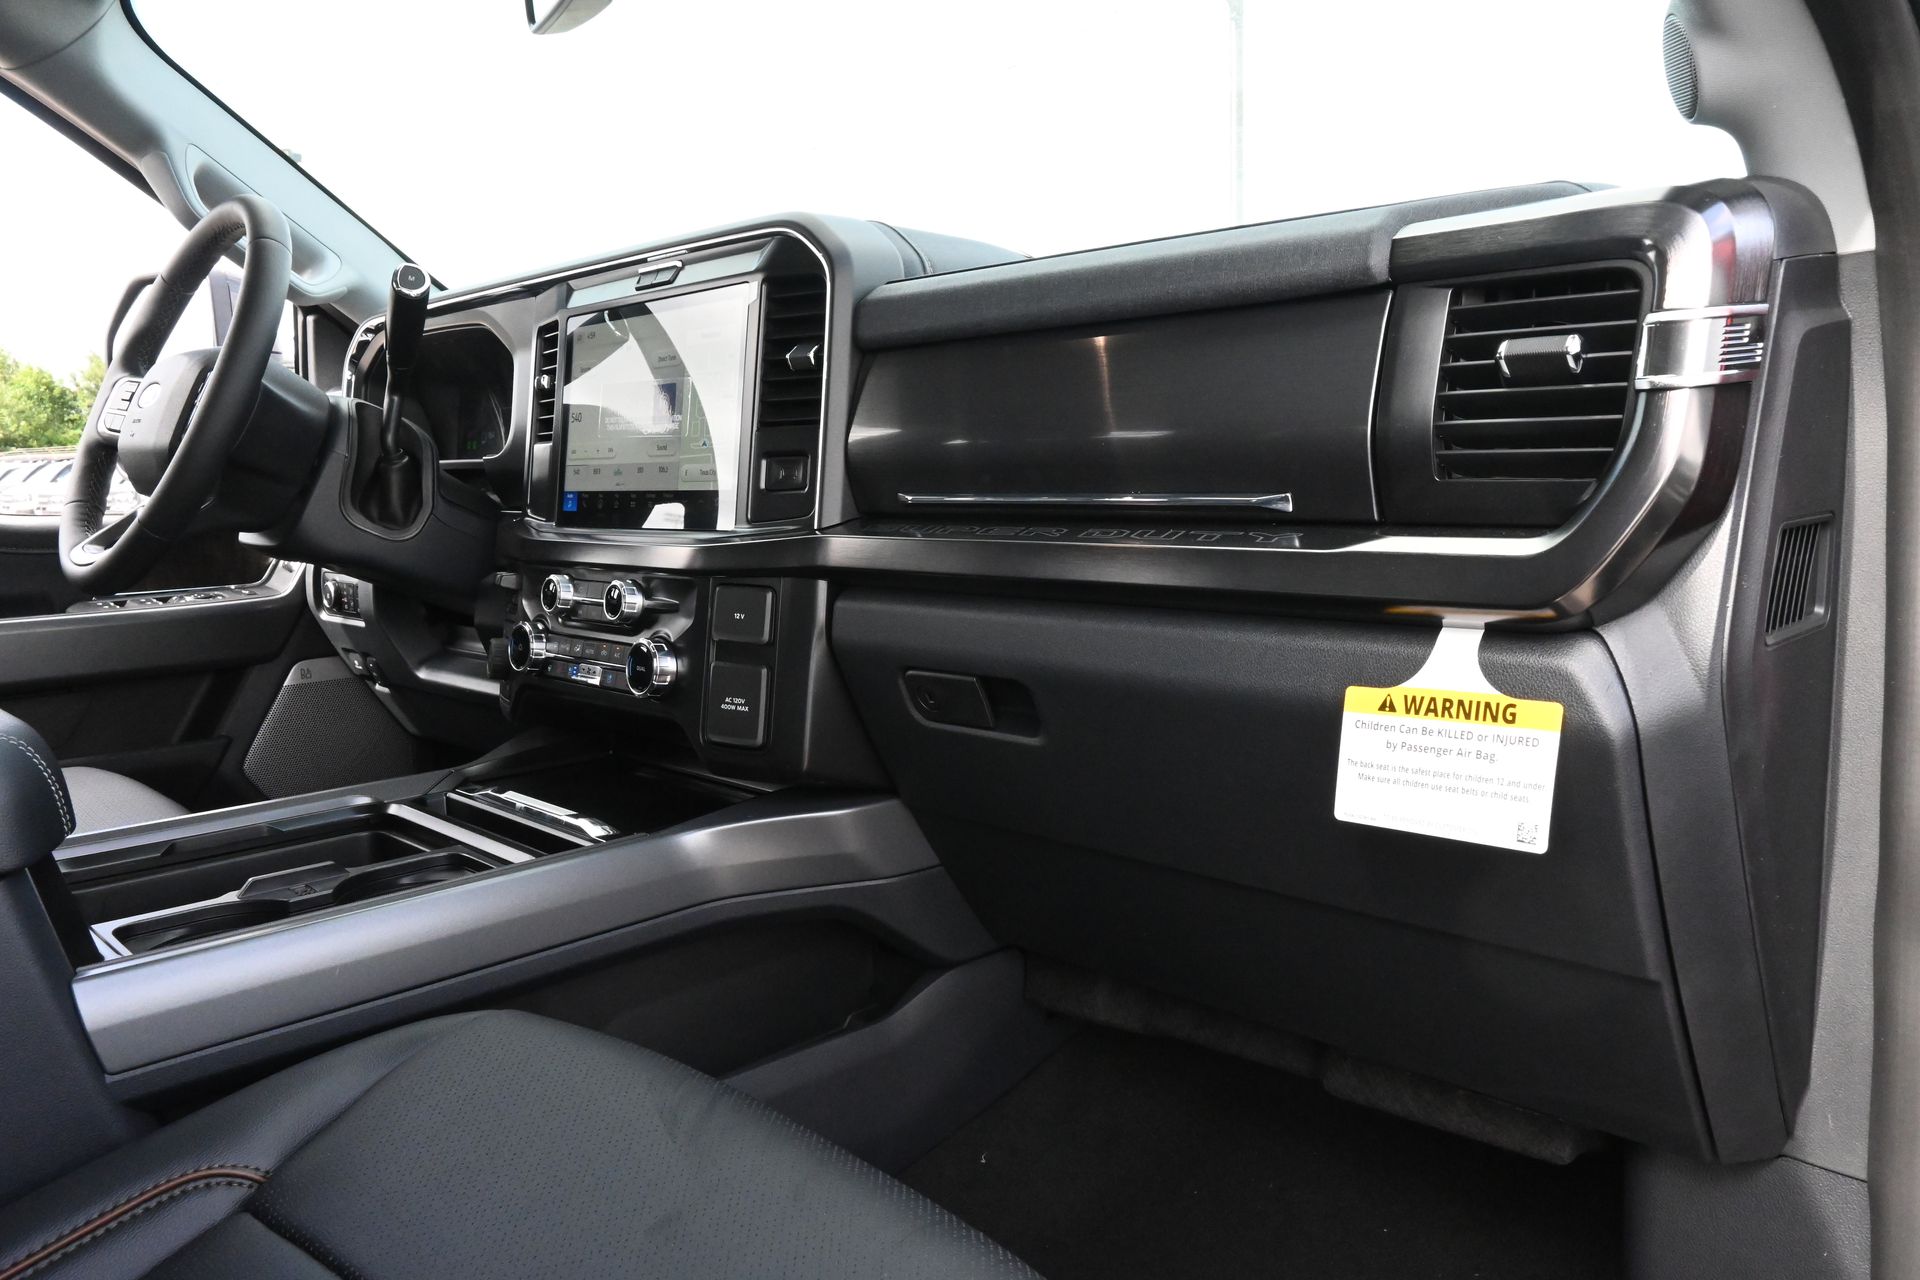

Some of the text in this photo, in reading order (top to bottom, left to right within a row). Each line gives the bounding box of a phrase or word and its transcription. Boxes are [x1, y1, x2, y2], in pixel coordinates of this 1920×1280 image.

[571, 412, 582, 423] 540
[1077, 527, 1303, 545] DUTY
[1404, 694, 1517, 724] WARNING
[1355, 719, 1540, 748] Children Can Be KILLED or INJURED
[1386, 739, 1398, 752] by
[1401, 741, 1453, 757] Passenger
[1457, 747, 1472, 758] Air
[1347, 758, 1358, 768] The
[1359, 760, 1374, 770] back
[1376, 763, 1390, 772] seat
[1391, 764, 1397, 773] is
[1398, 765, 1409, 774] the
[1411, 766, 1431, 777] safest
[1432, 769, 1450, 780] place
[1453, 771, 1463, 781] for
[1464, 772, 1494, 785] children
[1497, 777, 1505, 786] 12
[1507, 778, 1522, 788] and
[1358, 772, 1375, 782] Make
[1377, 775, 1391, 784] sure
[1392, 777, 1401, 785] all
[1402, 777, 1429, 789] children
[1431, 782, 1443, 791] use
[1444, 784, 1459, 794] seat
[1461, 786, 1478, 796] belts
[1480, 789, 1489, 797] or
[1490, 790, 1508, 800] child
